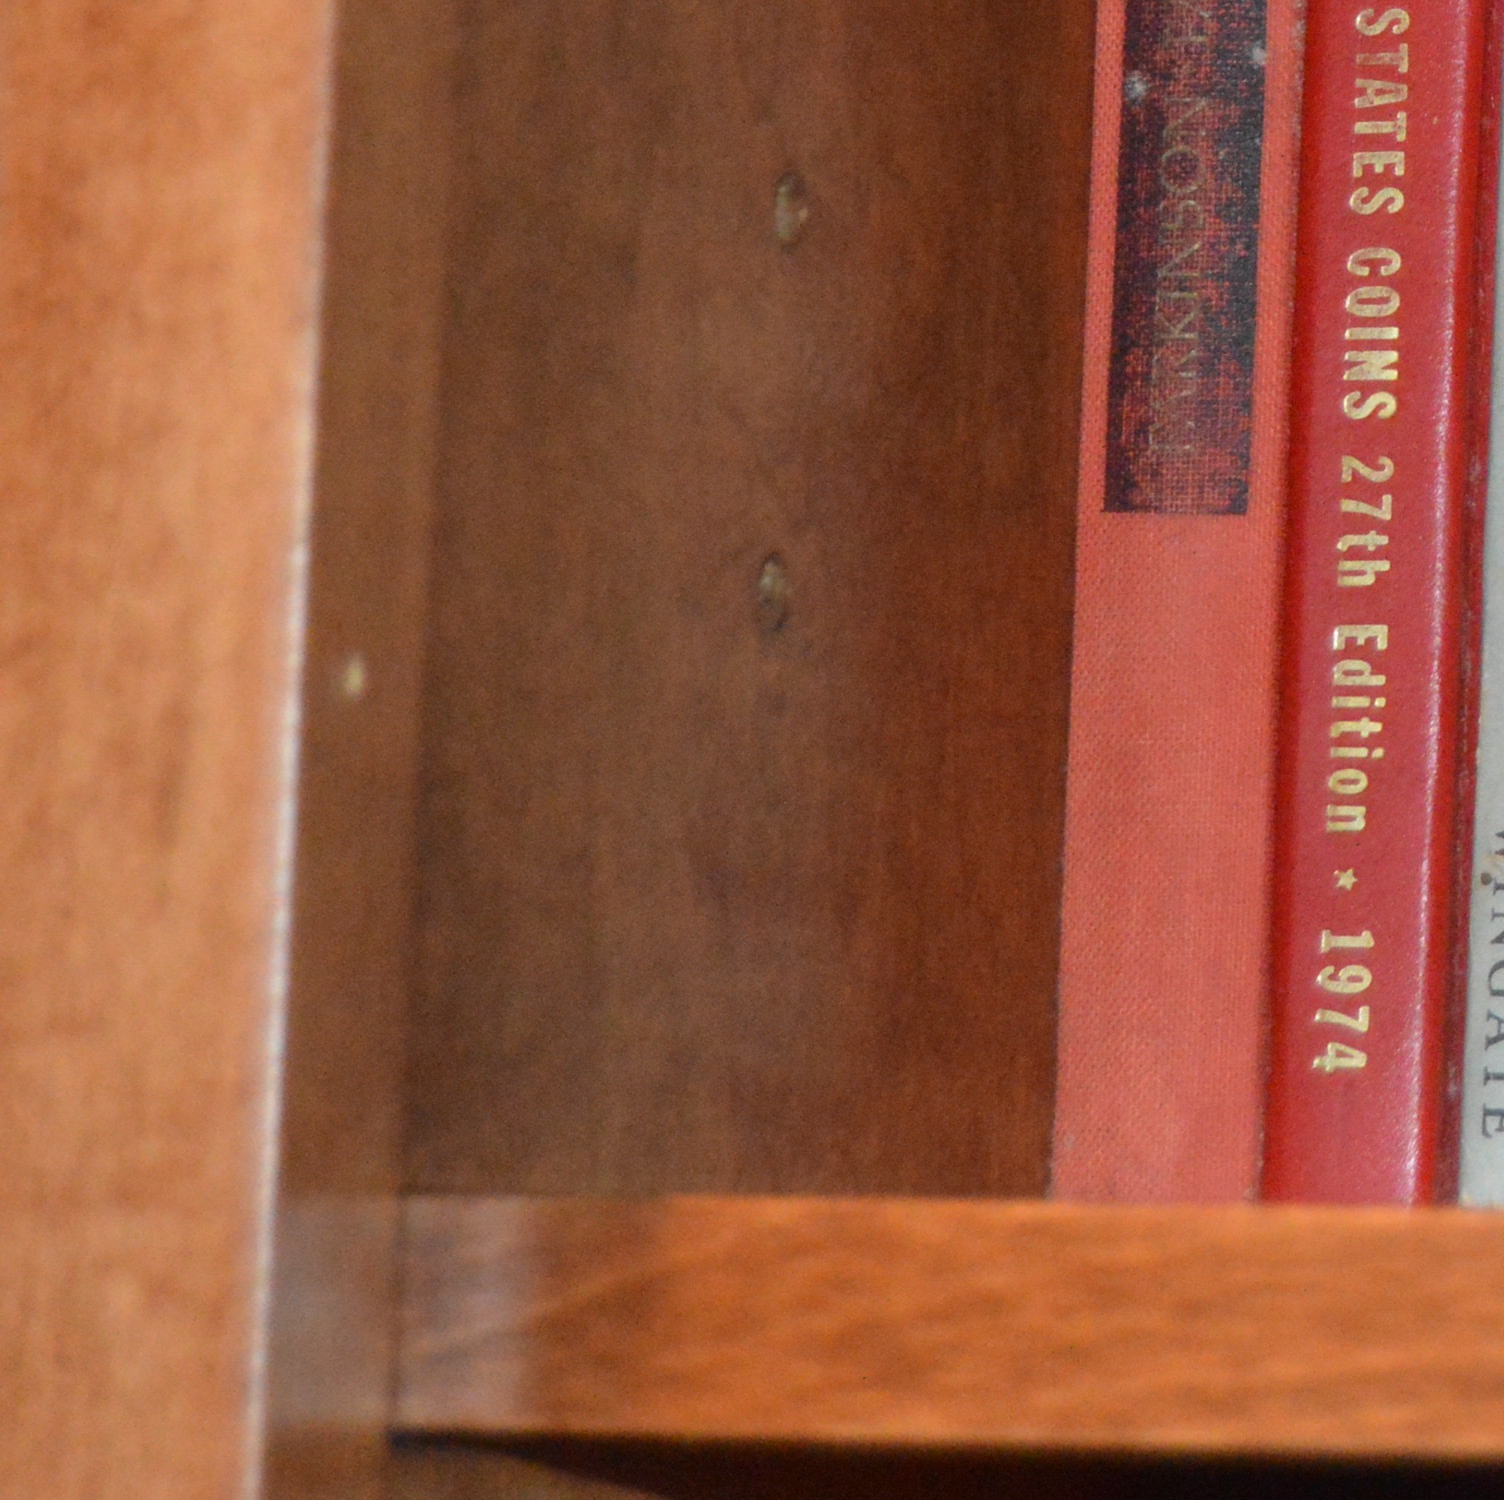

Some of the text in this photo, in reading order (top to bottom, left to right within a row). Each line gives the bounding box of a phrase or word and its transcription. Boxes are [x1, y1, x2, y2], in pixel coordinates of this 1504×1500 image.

[1349, 8, 1411, 215] STATES
[1341, 247, 1401, 420] COINS
[1335, 456, 1394, 587] 27th
[1324, 624, 1388, 833] Edition
[1312, 929, 1376, 1074] 1974
